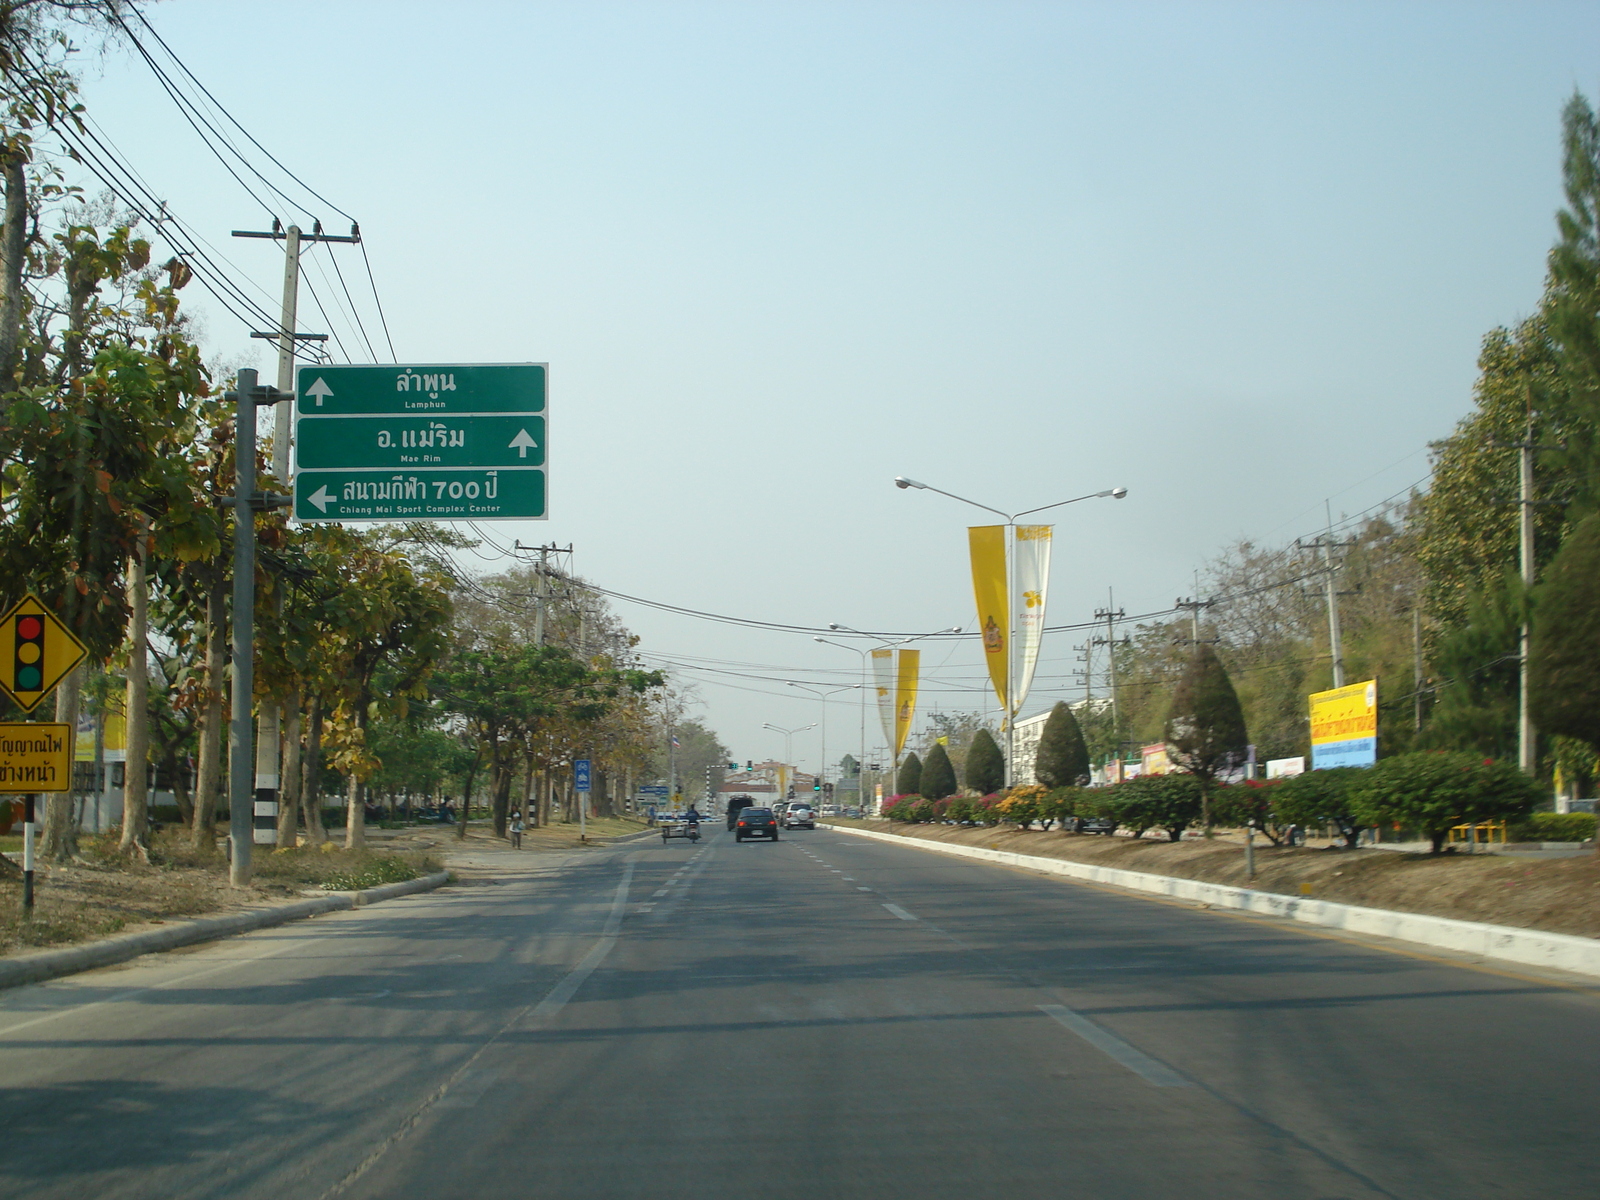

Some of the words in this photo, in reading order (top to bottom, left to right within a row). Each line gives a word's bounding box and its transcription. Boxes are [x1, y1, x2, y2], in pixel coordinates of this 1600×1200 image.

[396, 368, 457, 399] ลำพูน
[405, 401, 446, 409] Lamphun
[343, 475, 426, 500] สนามกีฬา
[432, 481, 480, 499] 700
[485, 470, 498, 499] ปี
[340, 506, 372, 515] Chiang
[375, 505, 393, 513] Mai
[396, 505, 422, 514] Sport
[426, 505, 465, 513] Complex
[469, 504, 501, 512] Center
[0, 733, 62, 757] ัญญาณไฟ
